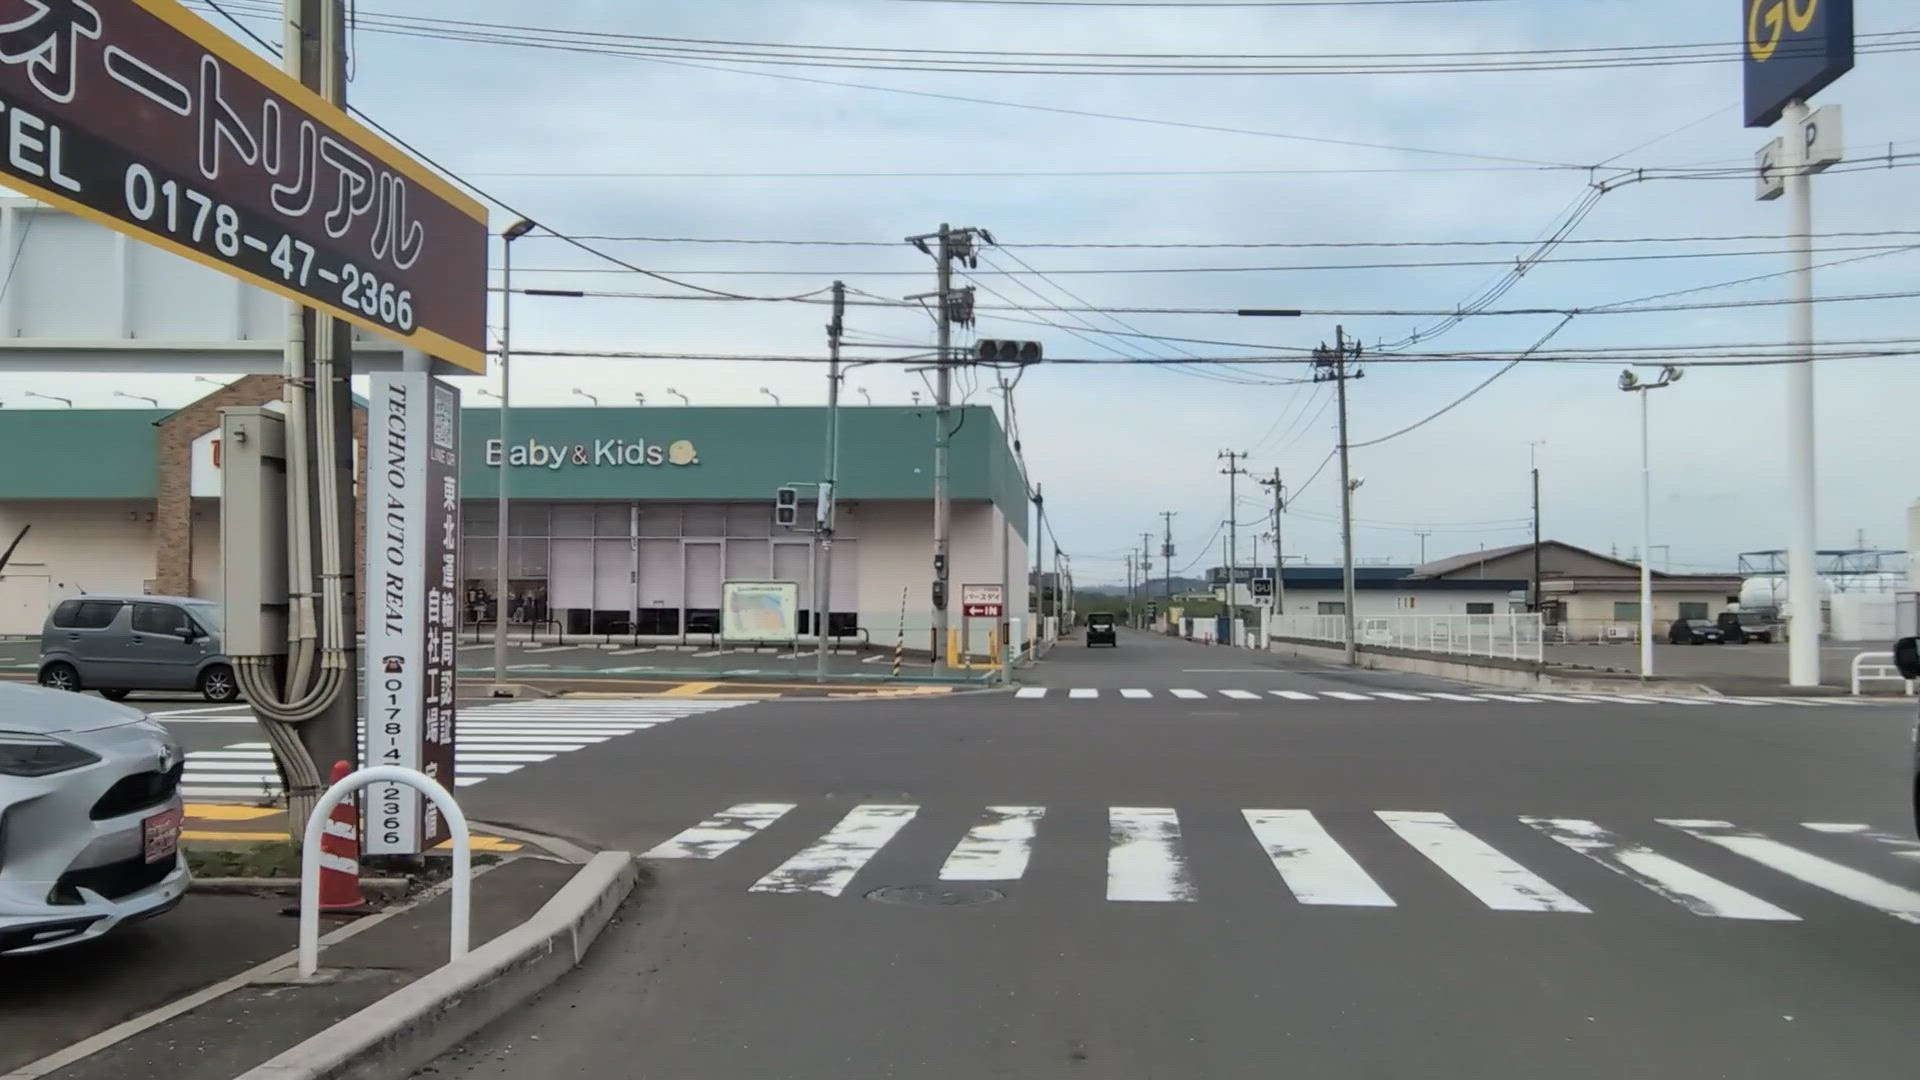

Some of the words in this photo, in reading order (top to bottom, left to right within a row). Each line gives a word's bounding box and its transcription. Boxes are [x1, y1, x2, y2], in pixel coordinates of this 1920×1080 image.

[1805, 122, 1817, 160] P
[0, 101, 81, 192] EL
[125, 163, 413, 330] 0178-47-2366
[387, 384, 406, 489] TECHNO
[485, 438, 568, 469] Baby
[572, 445, 588, 465] &
[594, 438, 663, 466] Kids
[386, 493, 405, 566] AUTO
[385, 571, 404, 637] REAL
[984, 605, 998, 616] IN
[426, 587, 440, 743] 自社工場
[383, 679, 402, 844] 0178-4-2366
